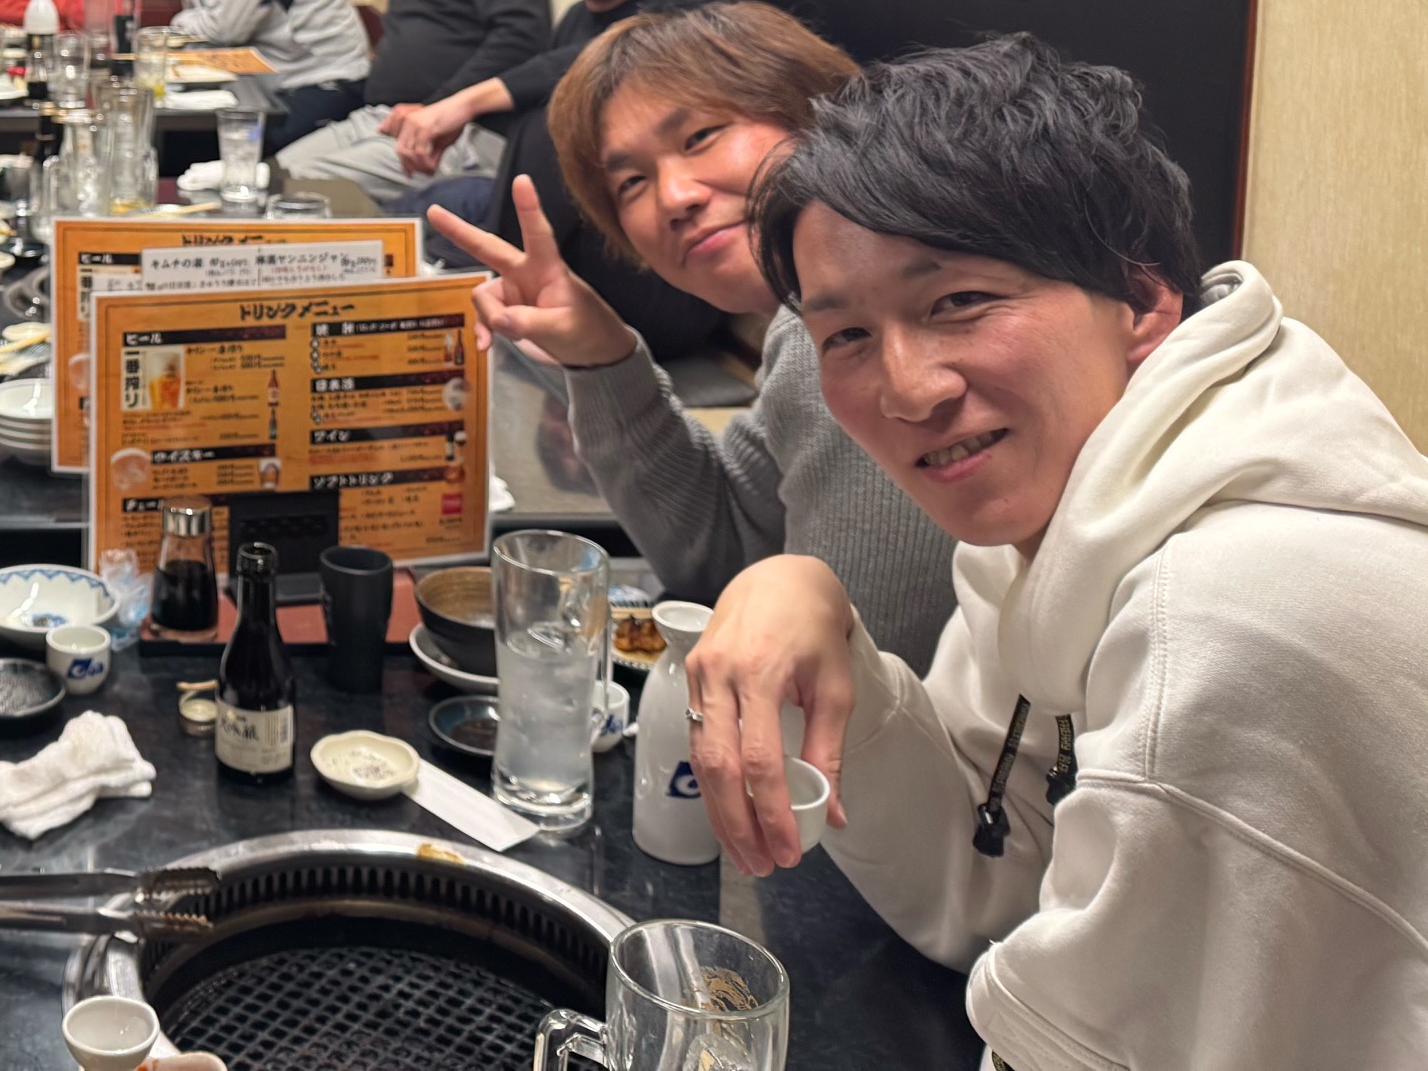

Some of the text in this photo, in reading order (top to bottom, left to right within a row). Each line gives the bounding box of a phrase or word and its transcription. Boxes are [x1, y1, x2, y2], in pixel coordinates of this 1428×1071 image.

[125, 332, 164, 346] ビール
[124, 350, 141, 409] 一番搾り
